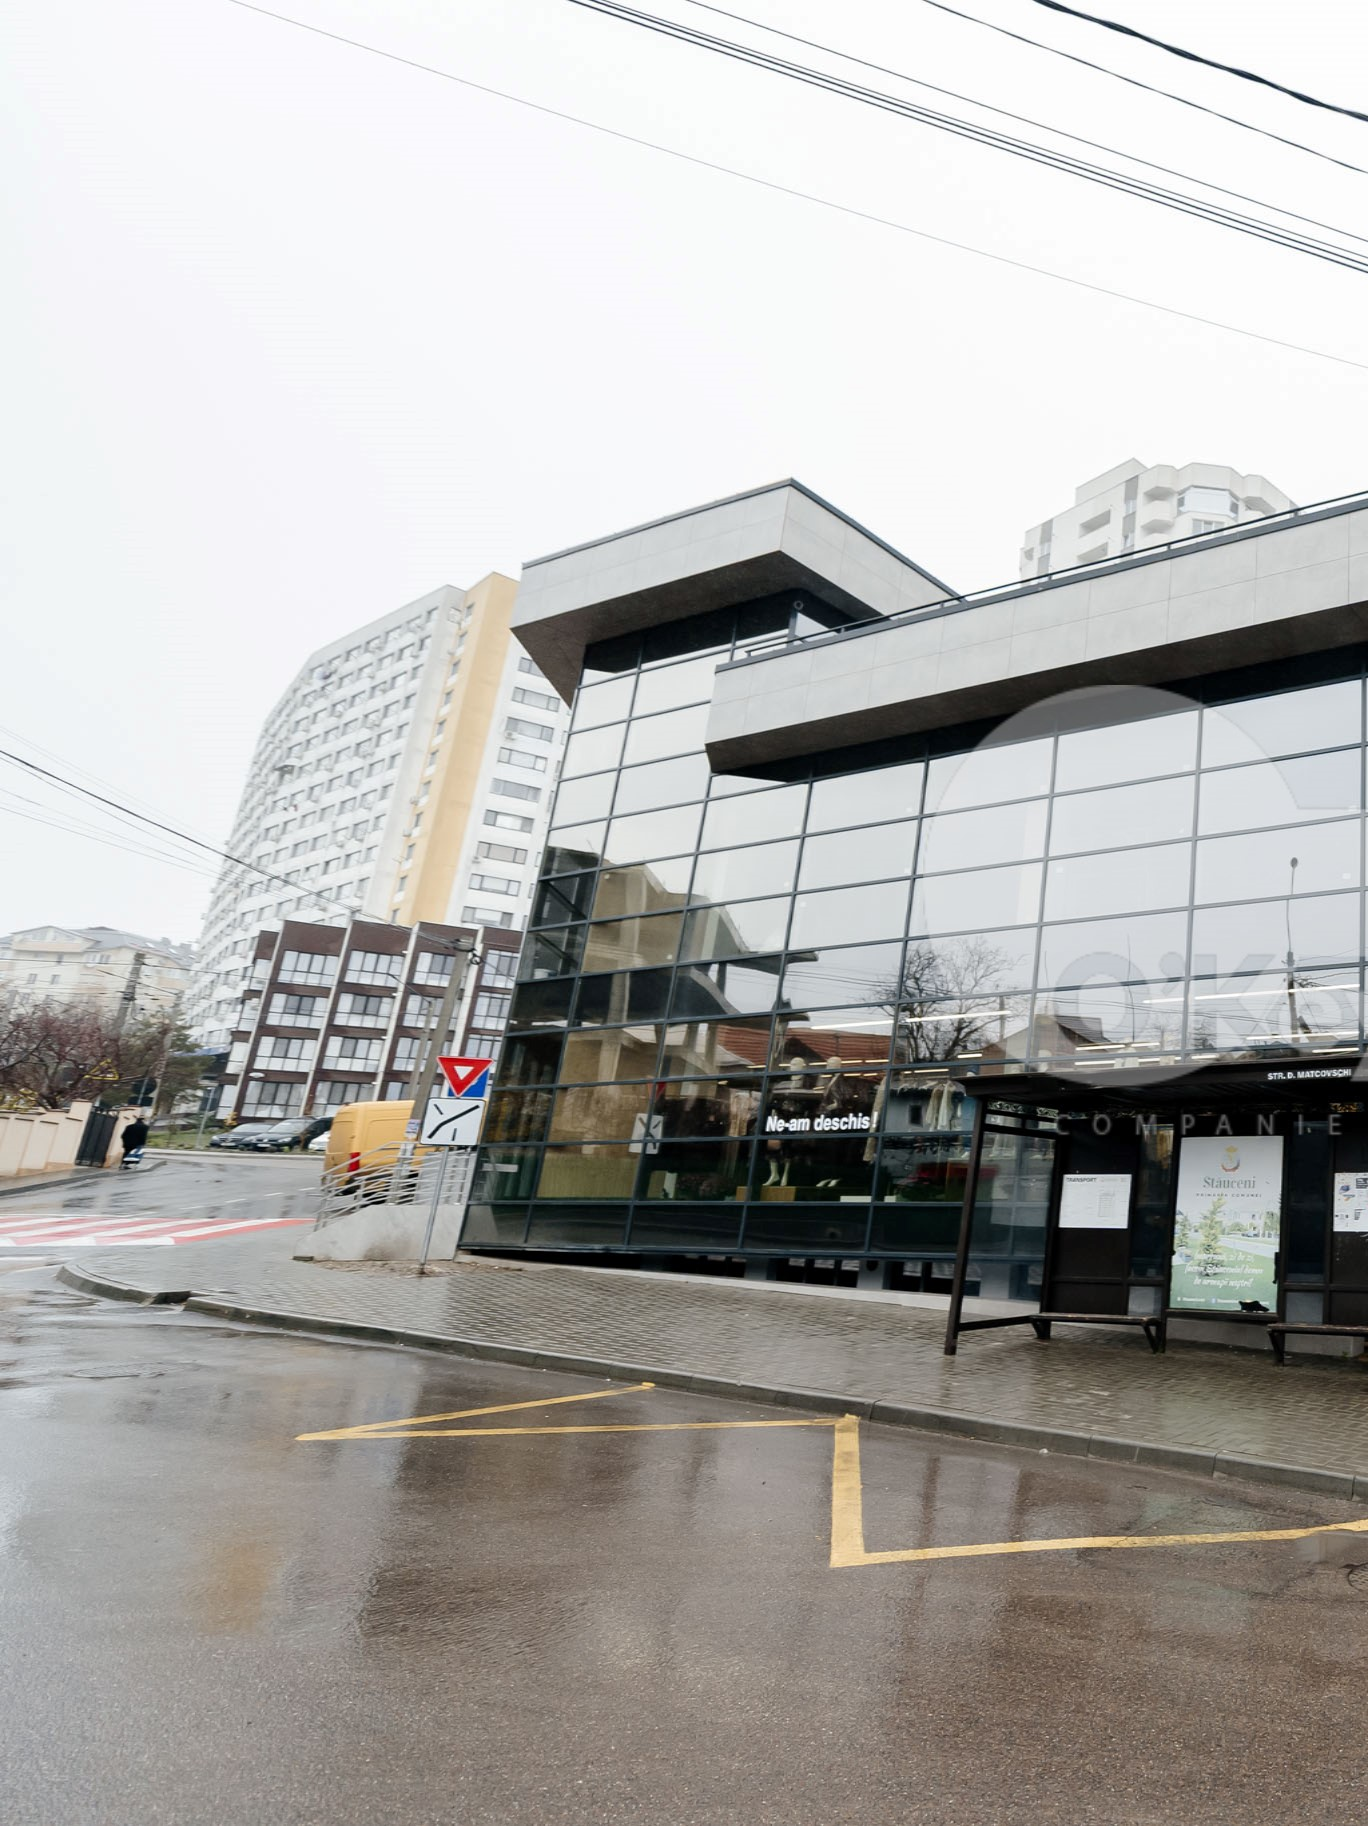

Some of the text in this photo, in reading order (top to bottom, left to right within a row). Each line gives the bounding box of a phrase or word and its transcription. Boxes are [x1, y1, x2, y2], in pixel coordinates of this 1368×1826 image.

[1267, 1072, 1286, 1081] STR.
[1287, 1071, 1296, 1079] D.
[1297, 1068, 1352, 1079] MATCOVSCHI
[765, 1115, 811, 1132] Ne-am
